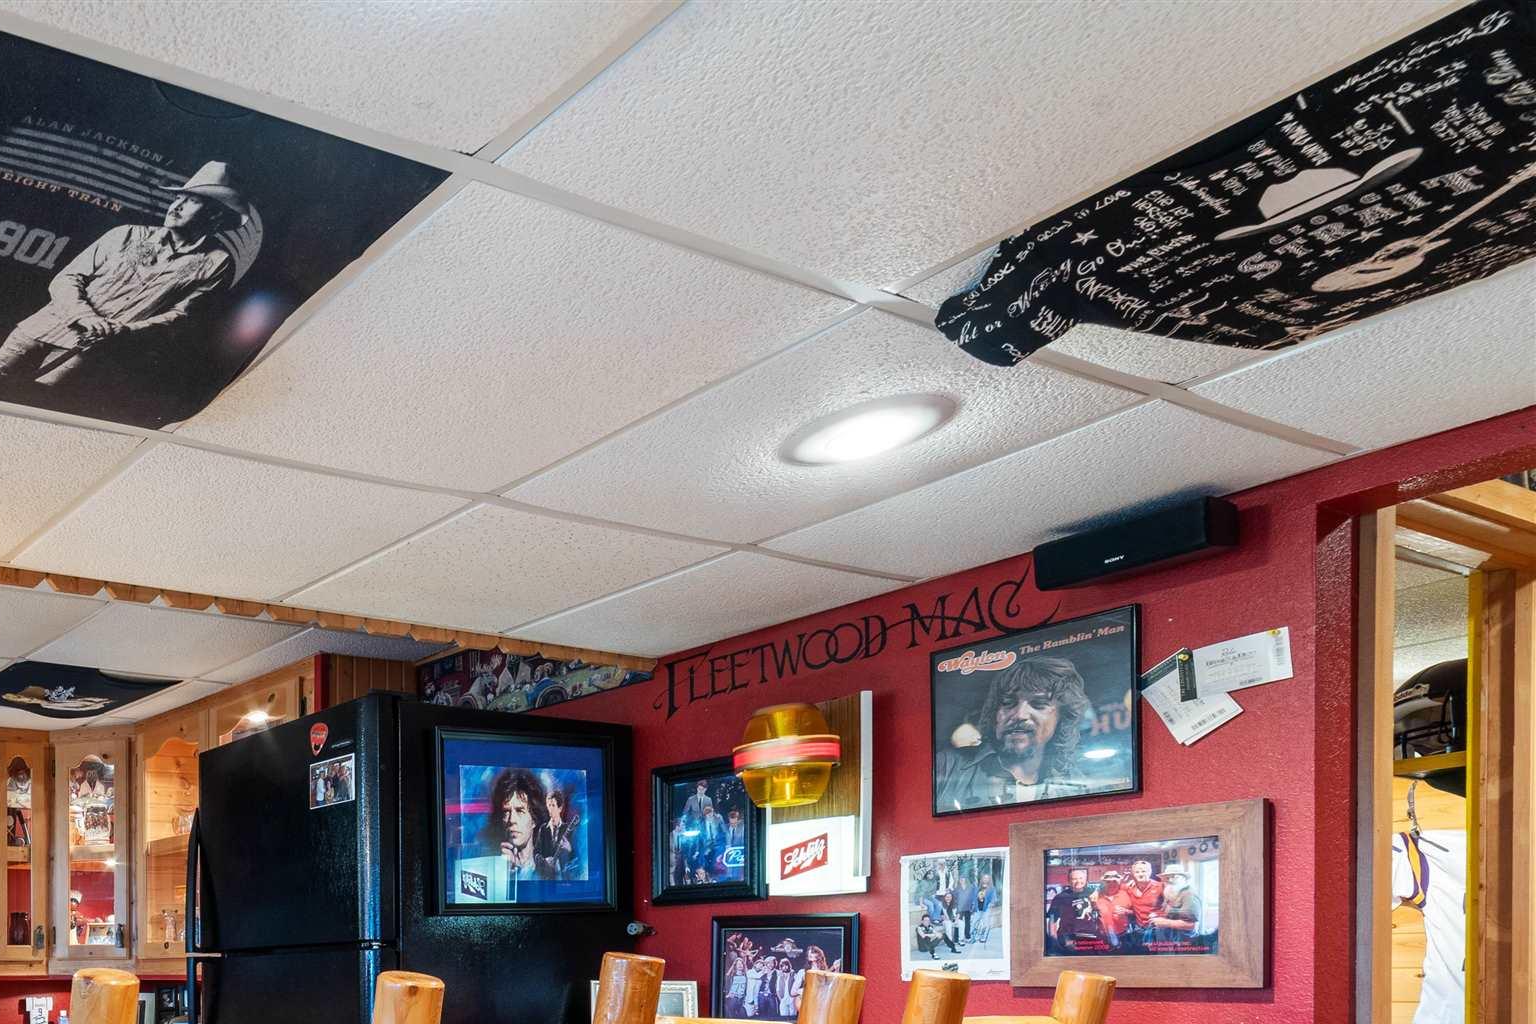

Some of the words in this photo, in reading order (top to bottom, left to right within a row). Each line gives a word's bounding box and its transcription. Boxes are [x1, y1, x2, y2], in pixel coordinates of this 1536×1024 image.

[23, 115, 74, 133] ALAN
[81, 127, 163, 162] JACKSON
[67, 188, 124, 213] TRAIN
[1237, 166, 1485, 281] STRAIT
[1268, 182, 1407, 246] GEORGE
[1104, 554, 1125, 564] SONY
[653, 615, 888, 720] FLEETWOOD
[902, 558, 1062, 649] MAC
[937, 650, 1017, 675] Waylon
[1018, 643, 1041, 656] The
[1042, 629, 1096, 651] Ramblin'
[1096, 624, 1125, 638] Man
[782, 836, 827, 875] Schlitz
